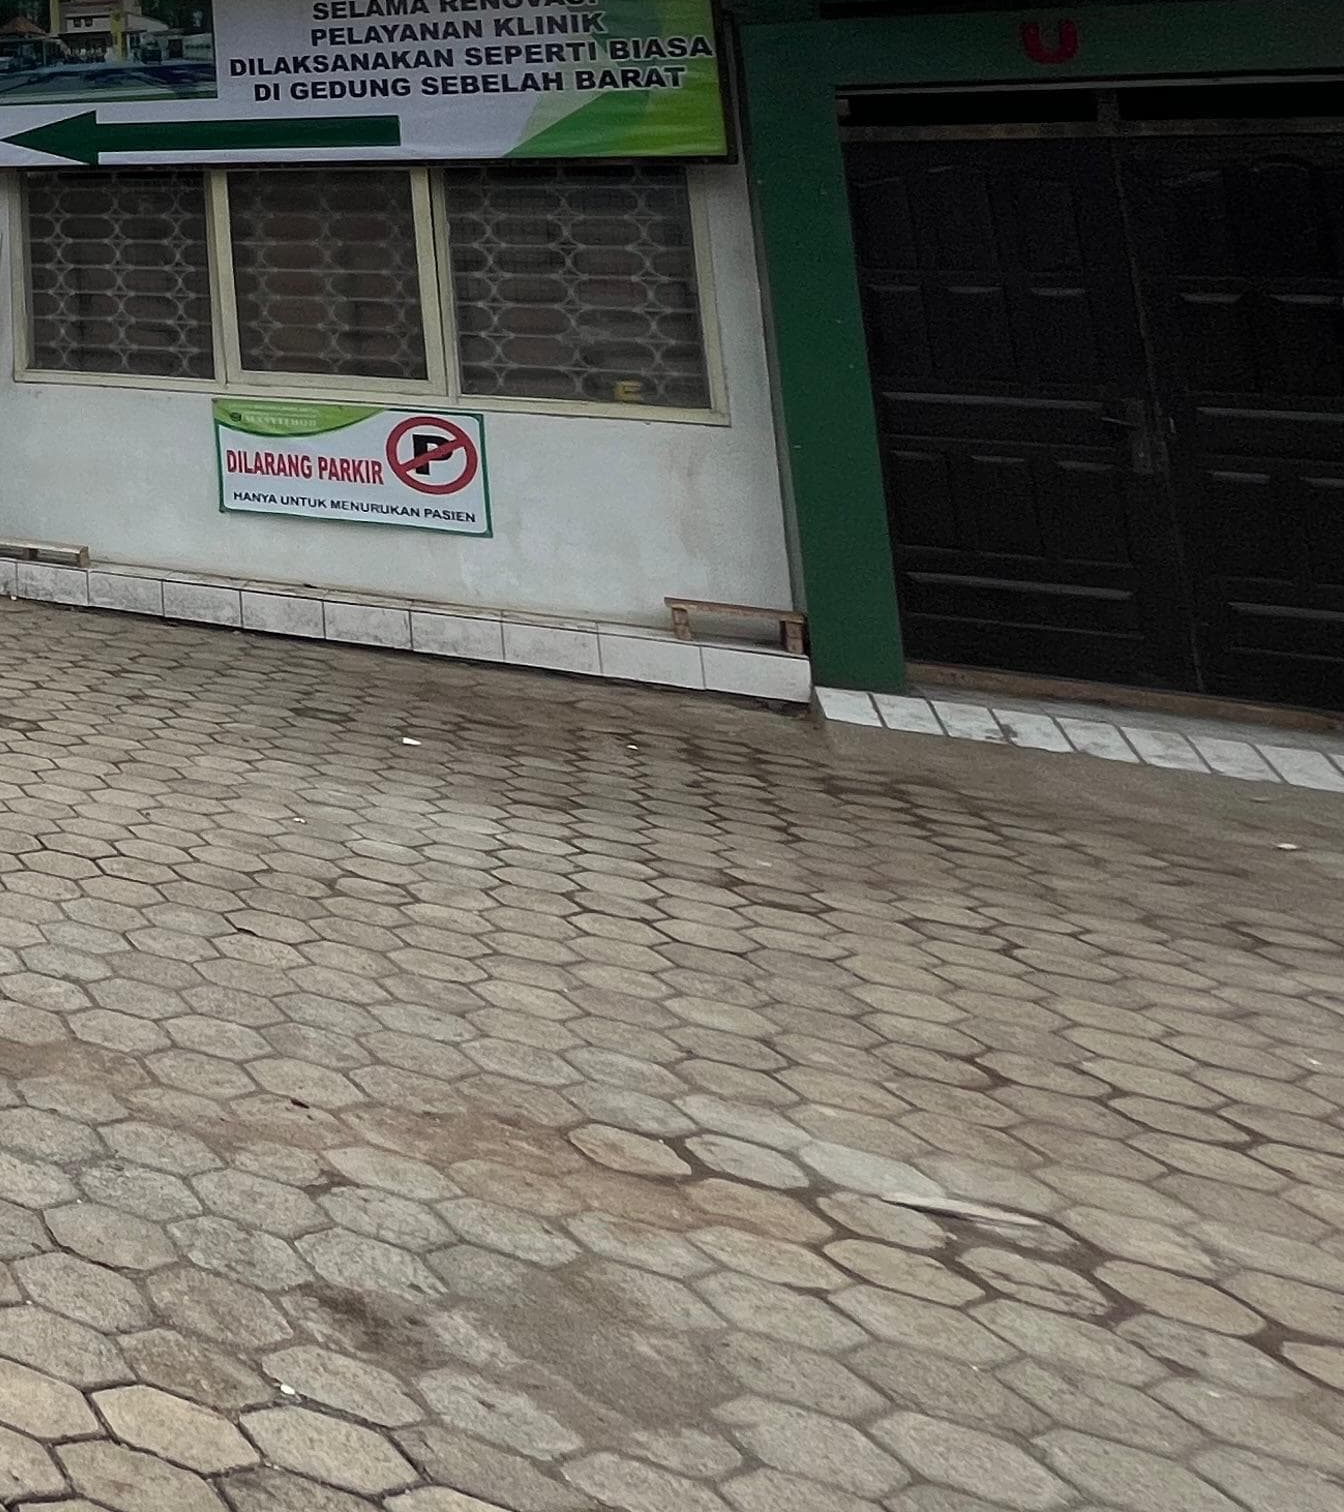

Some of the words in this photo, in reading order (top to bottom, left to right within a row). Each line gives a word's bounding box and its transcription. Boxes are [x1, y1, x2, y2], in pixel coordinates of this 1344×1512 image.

[311, 16, 483, 47] PELAYANAN
[493, 11, 606, 38] KLINIK
[229, 49, 454, 77] DILAKSANAKAN
[464, 41, 597, 67] SEPERTI
[610, 35, 713, 61] BIASA
[254, 82, 281, 102] DI
[290, 77, 411, 101] GEDUNG
[421, 72, 564, 96] SEBELAH
[575, 66, 686, 91] BARAT
[226, 450, 312, 480] DILARANG
[318, 456, 385, 486] PARKIR
[233, 491, 278, 505] HANYA
[281, 495, 327, 509] UNTUK
[330, 499, 421, 519] MENURUKAN
[424, 507, 476, 524] PASIEN
